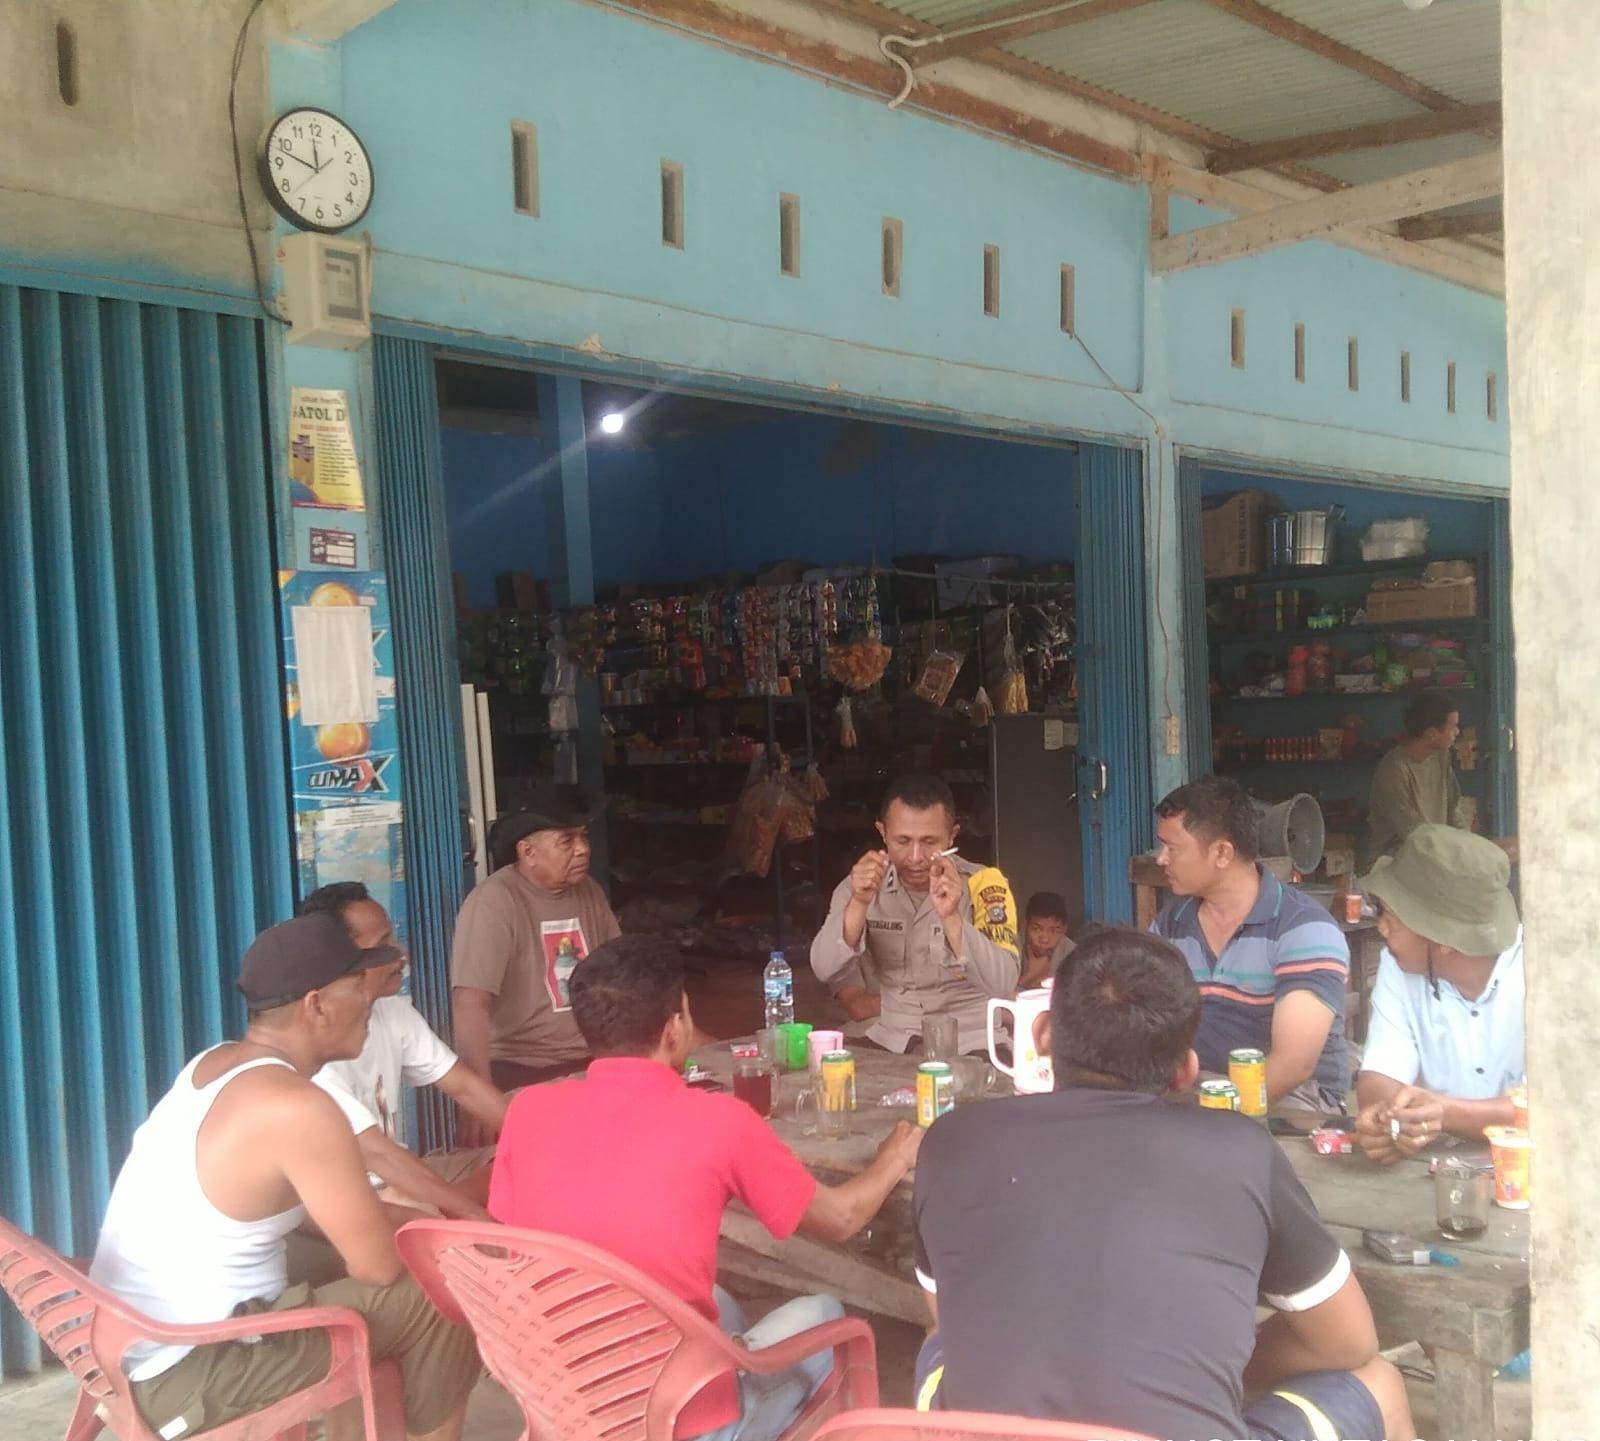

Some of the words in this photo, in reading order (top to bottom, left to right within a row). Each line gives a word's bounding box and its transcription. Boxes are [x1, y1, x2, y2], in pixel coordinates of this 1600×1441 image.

[292, 126, 303, 140] 11
[308, 123, 322, 138] 12
[278, 137, 292, 151] 10
[331, 134, 337, 147] 1
[275, 157, 284, 170] 9
[344, 151, 353, 164] 2
[281, 178, 290, 193] 8
[349, 172, 358, 186] 3
[297, 198, 306, 211] 7
[345, 192, 354, 206] 4
[315, 206, 324, 220] 6
[334, 204, 342, 218] 5
